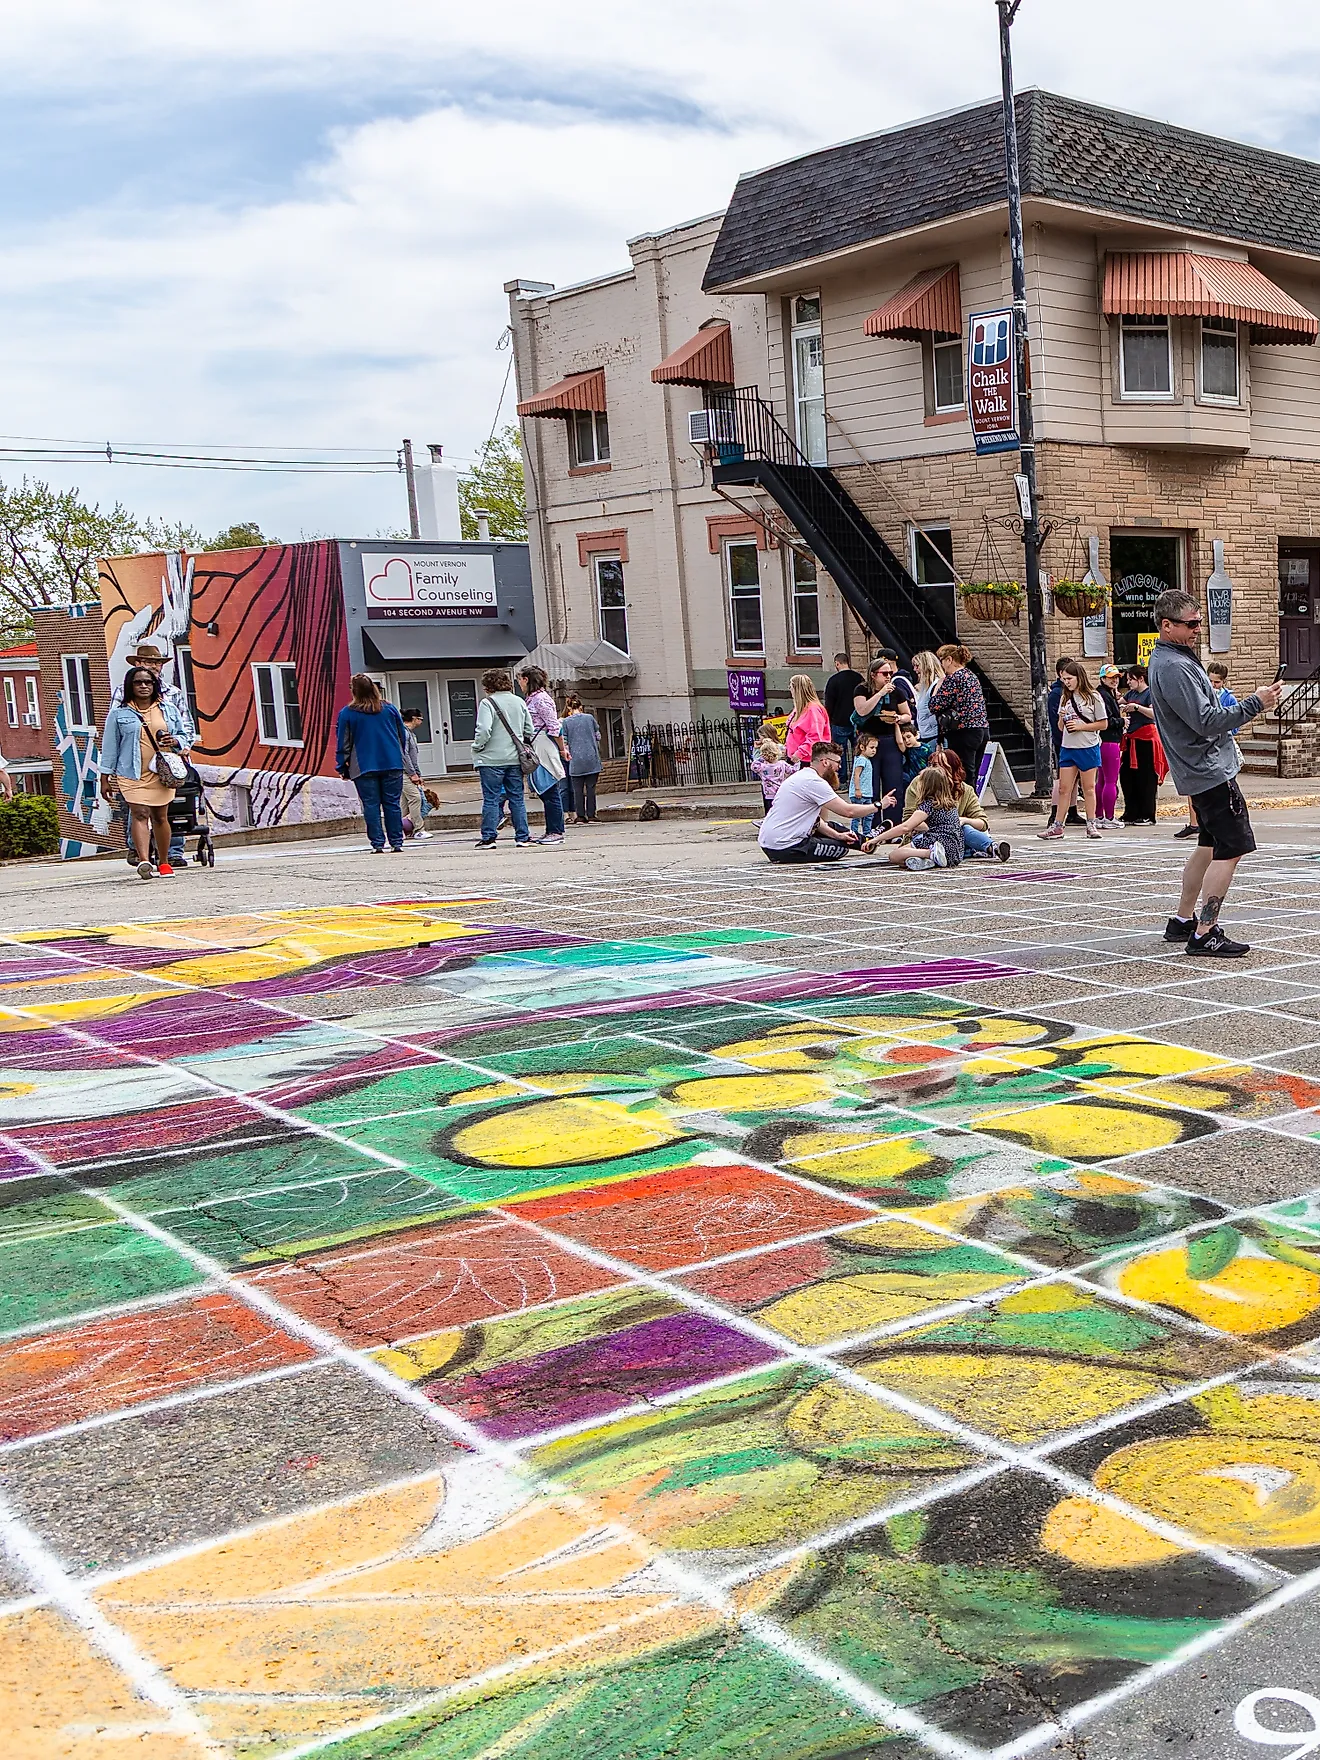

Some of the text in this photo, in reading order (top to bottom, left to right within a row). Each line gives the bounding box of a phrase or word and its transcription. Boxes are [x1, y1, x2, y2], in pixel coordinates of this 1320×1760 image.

[972, 368, 1009, 388] Chalk
[983, 387, 998, 397] THE
[975, 396, 1008, 415] Walk
[415, 573, 459, 587] Family
[417, 589, 493, 603] Counseling
[1125, 593, 1144, 601] wine
[1212, 590, 1229, 600] LWB
[1121, 610, 1135, 618] wood
[1136, 610, 1149, 618] fired
[740, 675, 760, 685] HAPPY
[743, 687, 759, 697] DAZE
